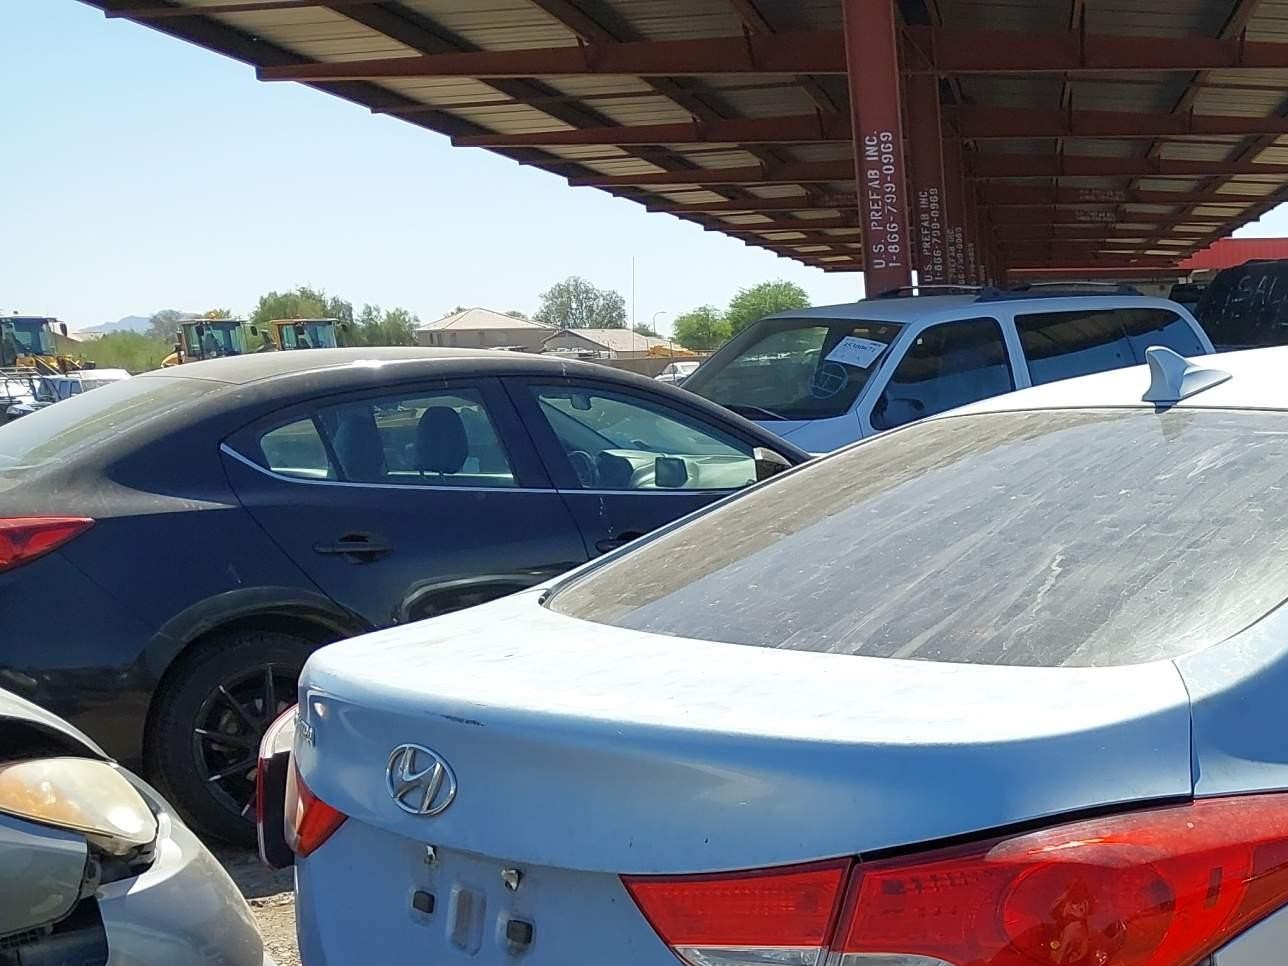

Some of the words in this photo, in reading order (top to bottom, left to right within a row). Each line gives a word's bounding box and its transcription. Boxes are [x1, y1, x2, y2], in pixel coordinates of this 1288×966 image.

[865, 130, 879, 161] INC.
[867, 169, 883, 230] PREFAB
[880, 131, 901, 267] 1-866-799-0969
[872, 239, 886, 269] U.S.
